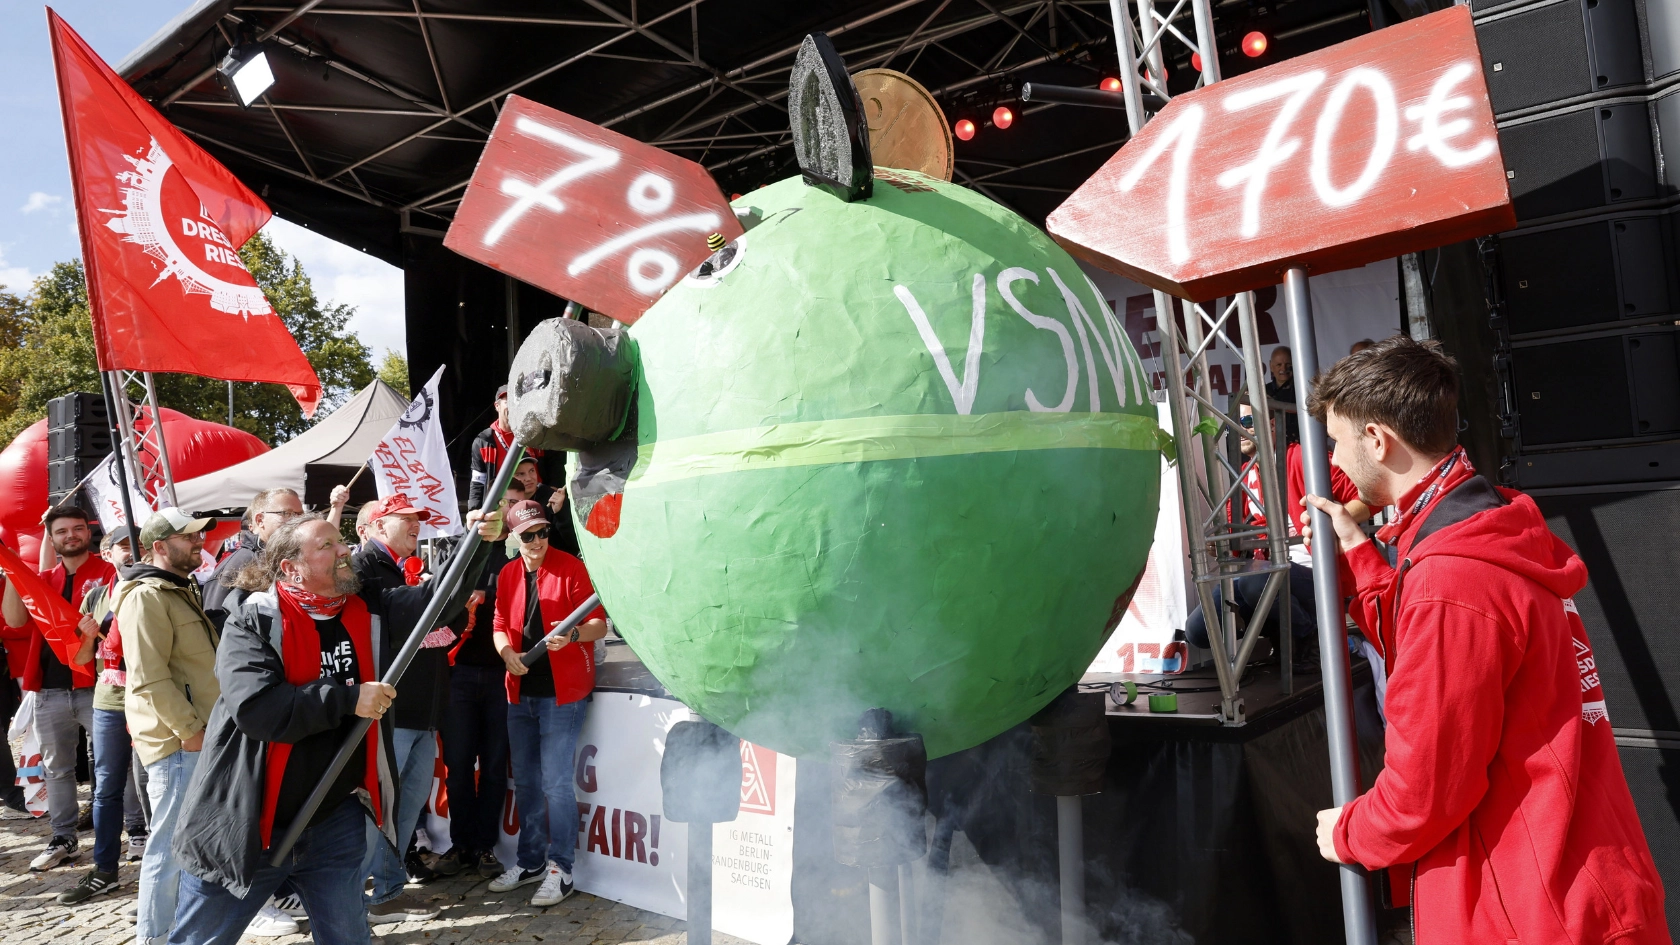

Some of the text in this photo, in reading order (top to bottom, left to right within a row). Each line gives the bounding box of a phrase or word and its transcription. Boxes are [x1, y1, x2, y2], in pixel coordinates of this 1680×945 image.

[181, 217, 233, 249] DRES
[204, 243, 249, 272] RIES
[893, 266, 1157, 416] VSM
[393, 435, 446, 504] ELBTAL
[729, 829, 774, 847] IG METALL
[711, 854, 772, 876] RANDENBURG-
[739, 845, 773, 861] BERLIN-
[730, 872, 771, 890] SACHSEN
